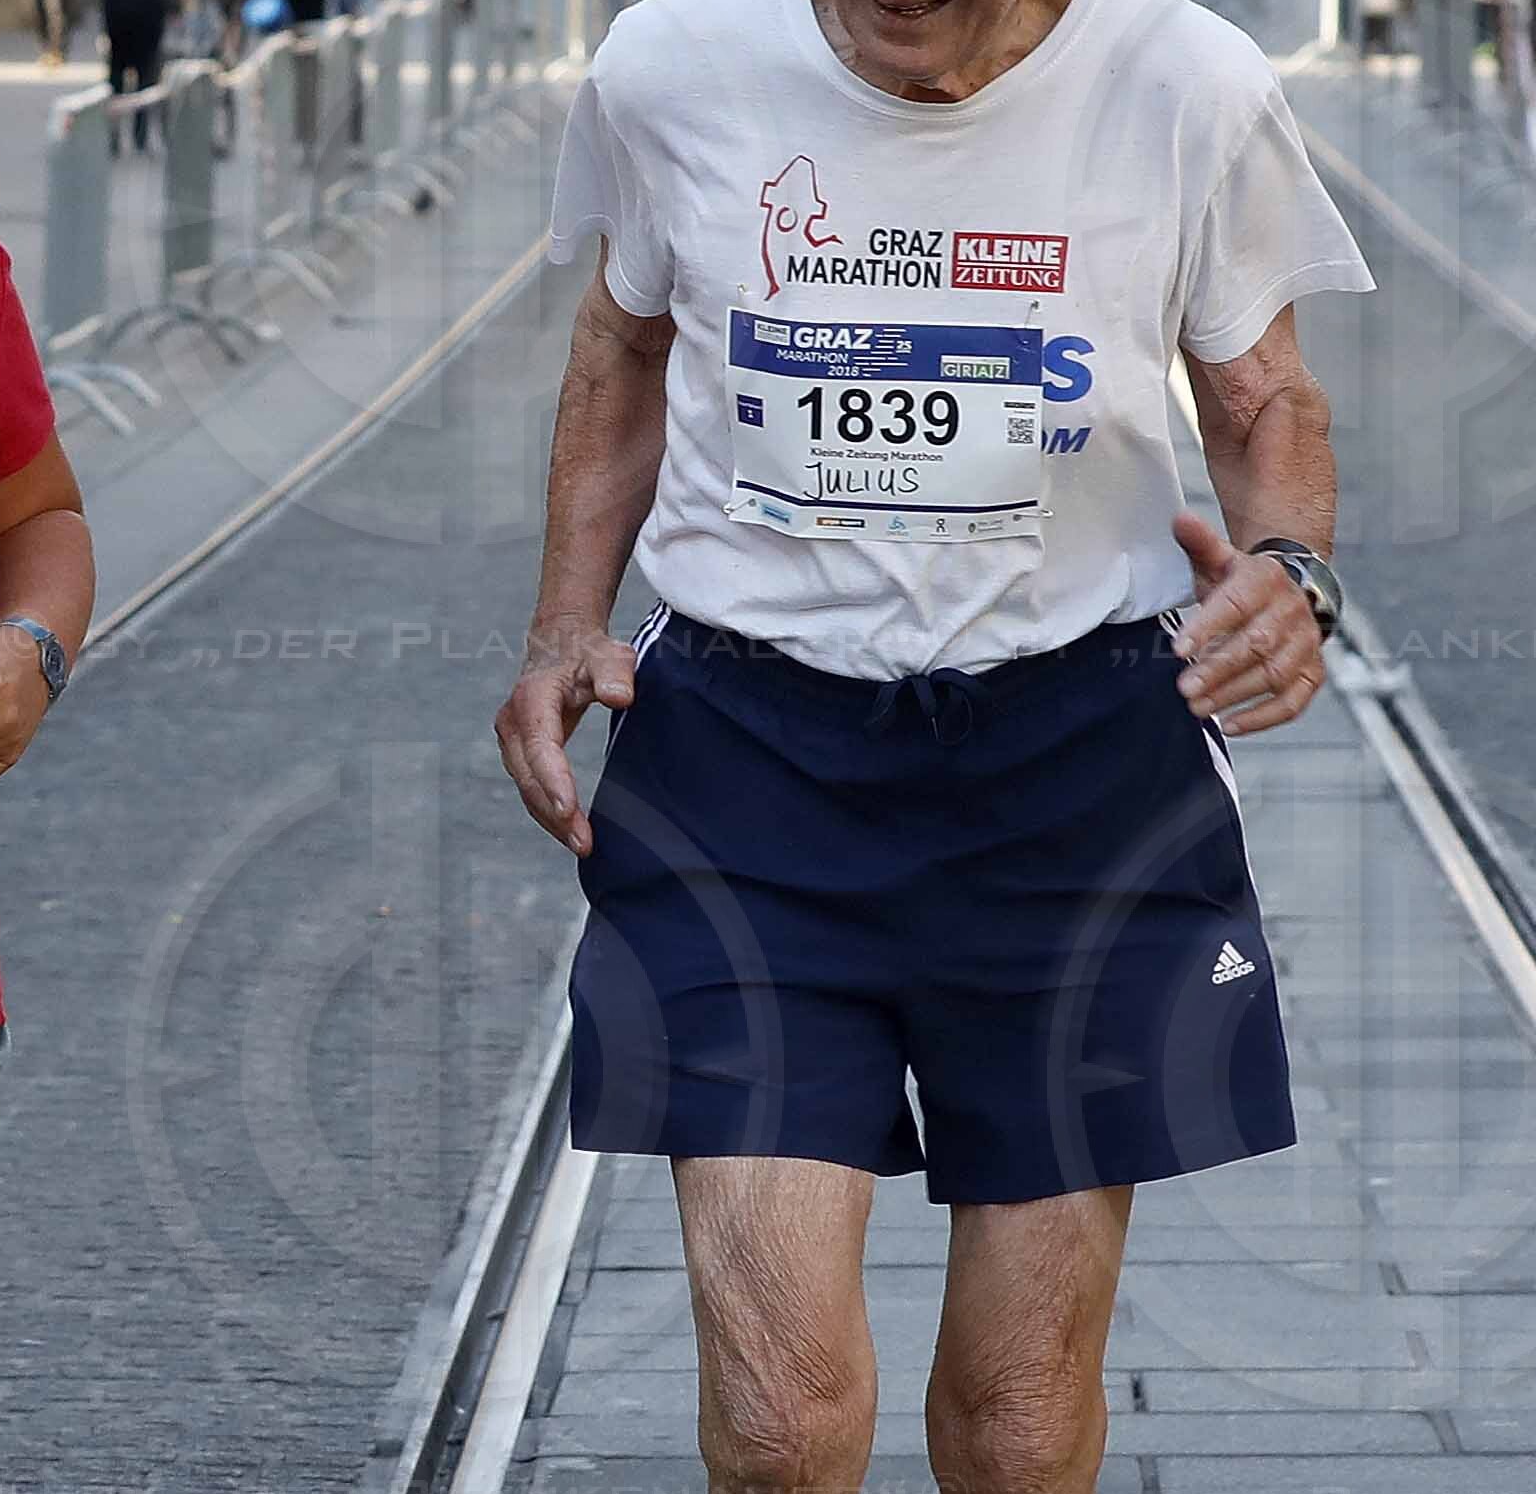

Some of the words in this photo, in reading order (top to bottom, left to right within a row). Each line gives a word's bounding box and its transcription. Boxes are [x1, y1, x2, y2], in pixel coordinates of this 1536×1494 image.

[869, 228, 943, 258] GRAZ
[956, 237, 1062, 264] KLEINE
[786, 255, 942, 289] MARATHON
[956, 266, 1061, 290] ZEITUNG
[793, 327, 874, 350] GRAZ
[775, 349, 849, 364] MARATHON
[827, 365, 860, 377] 2018
[942, 363, 1010, 379] GRAZ
[797, 386, 960, 445] 1839
[809, 447, 844, 458] Kleine
[845, 449, 889, 462] Zeitung
[890, 451, 944, 462] Marathon
[803, 461, 920, 500] JULIUS
[1211, 960, 1257, 986] adidas
